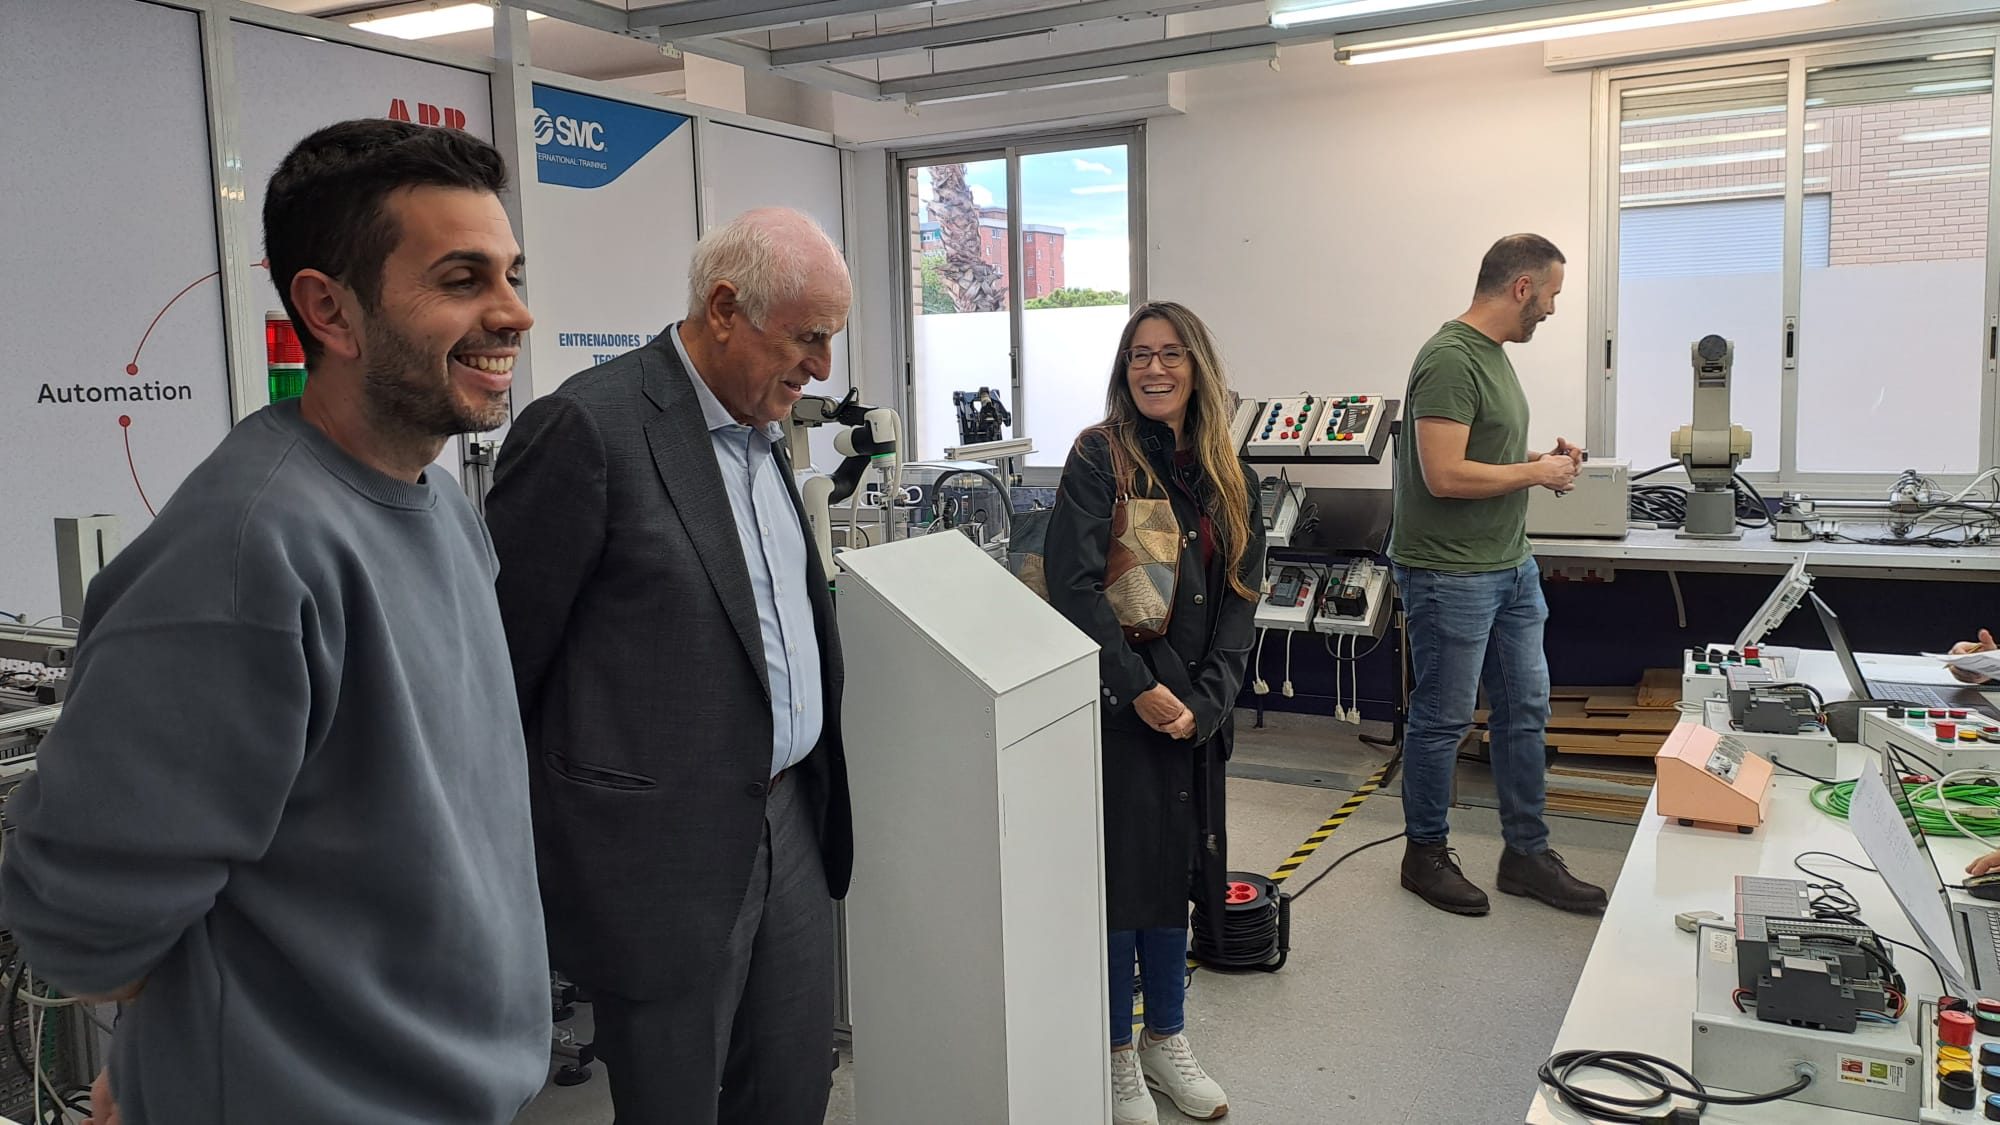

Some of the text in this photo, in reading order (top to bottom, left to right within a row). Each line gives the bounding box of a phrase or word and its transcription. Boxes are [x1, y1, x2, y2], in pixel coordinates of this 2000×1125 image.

[555, 115, 605, 151] SMC
[578, 158, 608, 170] TRAINING
[559, 333, 640, 347] ENTRENADORES
[37, 380, 192, 404] Automation
